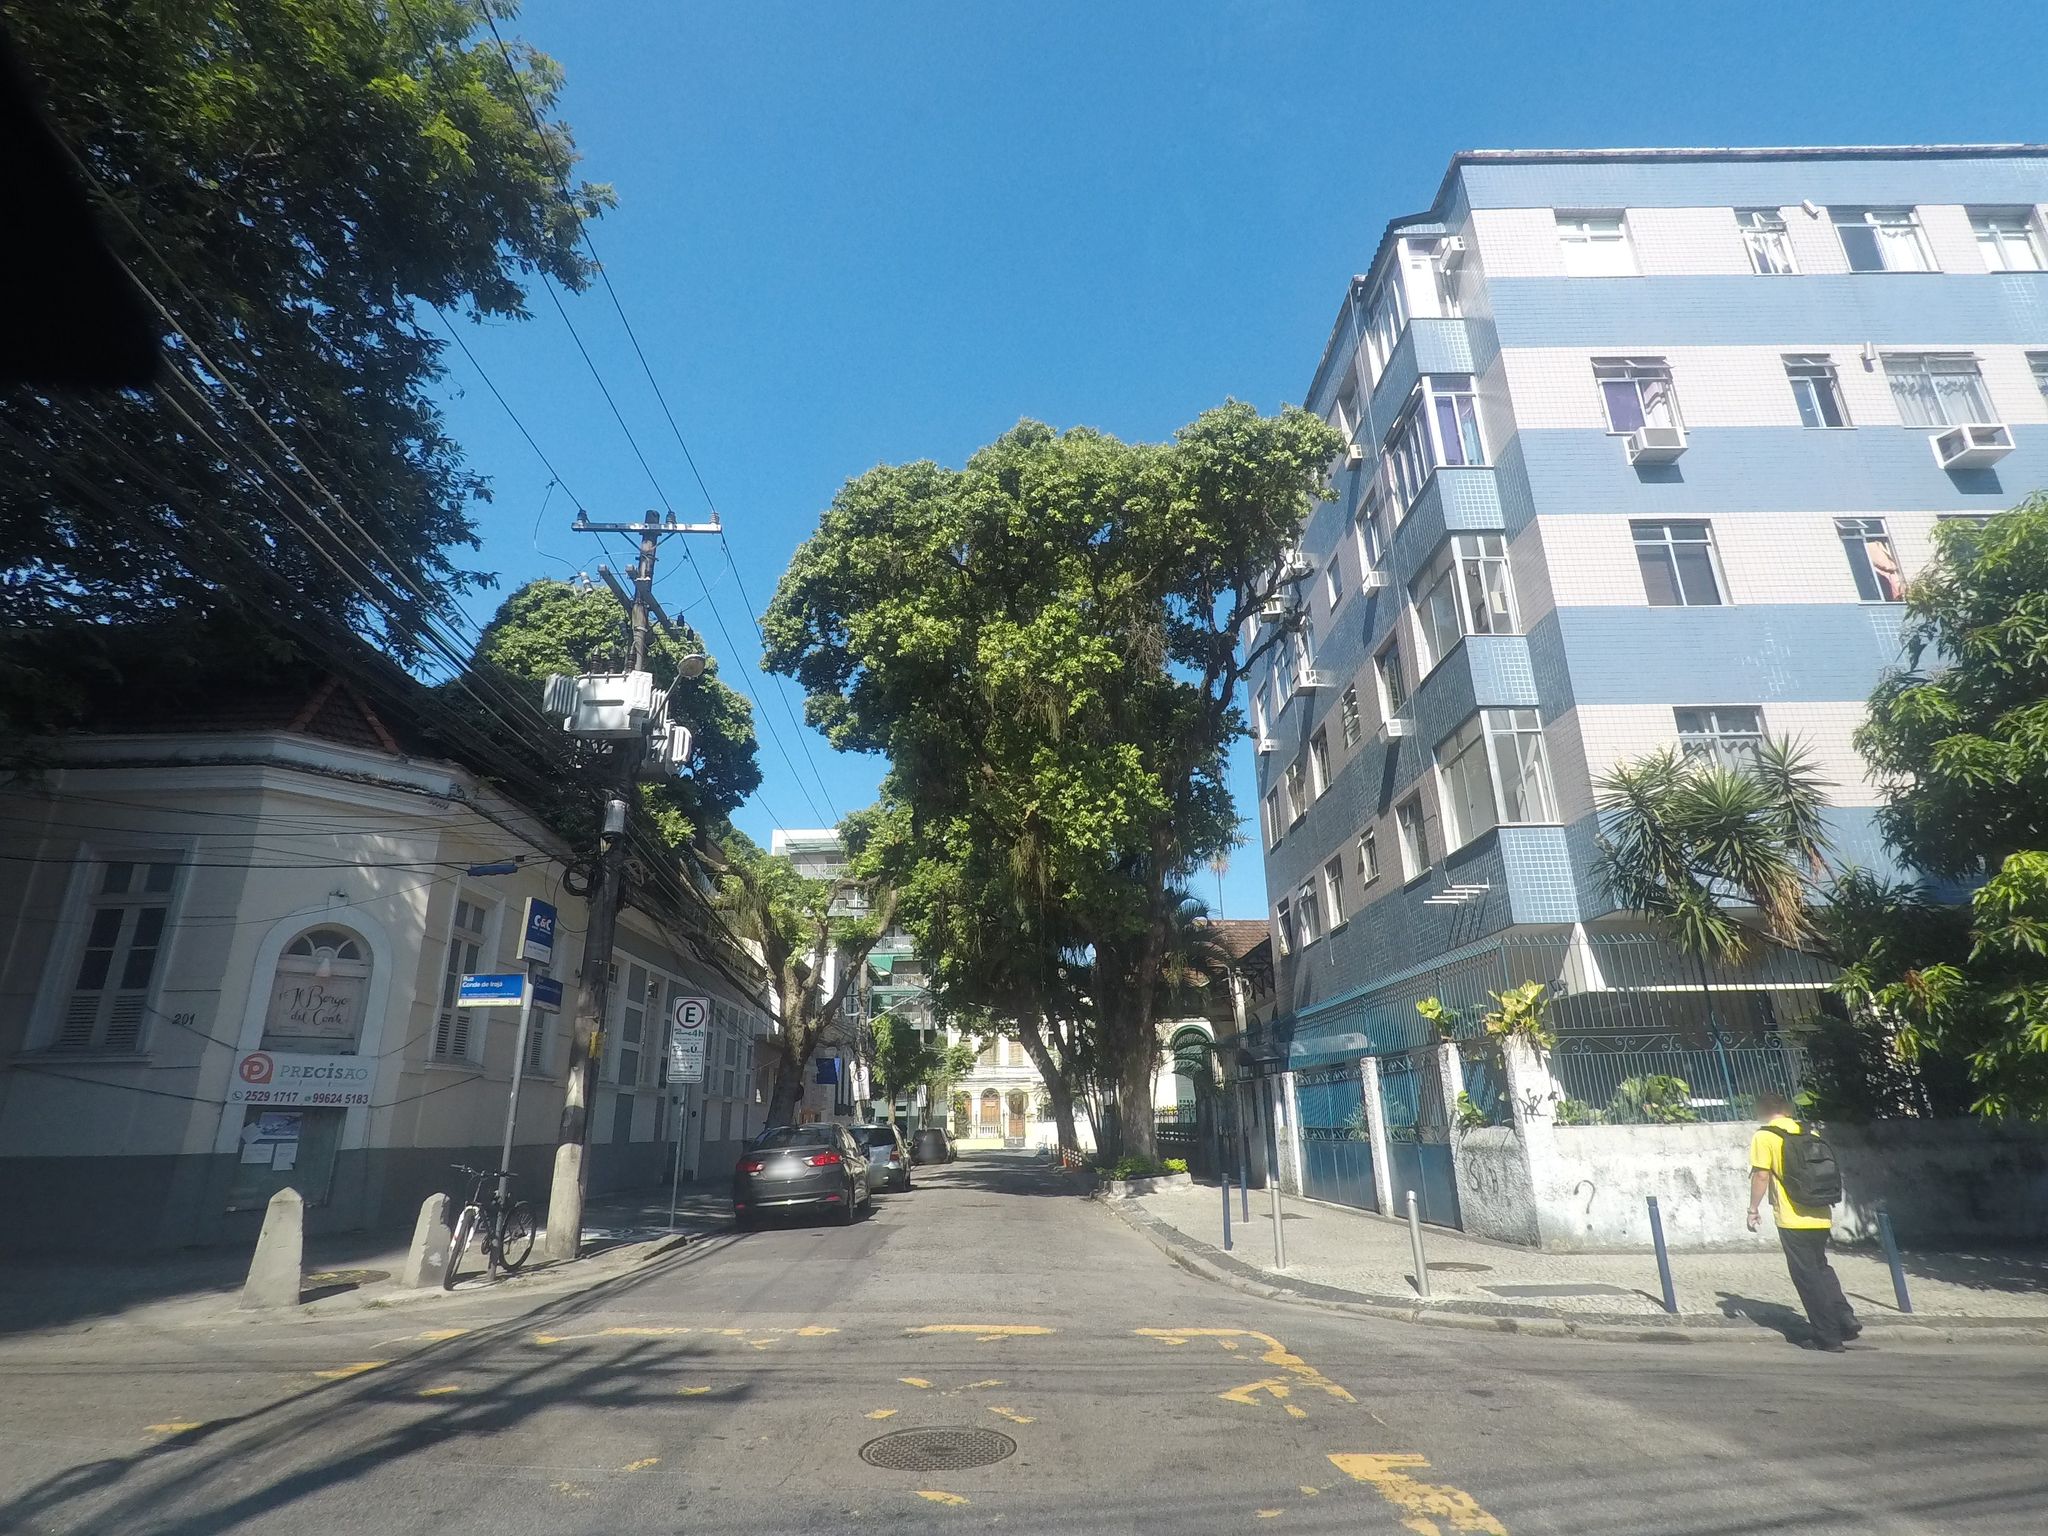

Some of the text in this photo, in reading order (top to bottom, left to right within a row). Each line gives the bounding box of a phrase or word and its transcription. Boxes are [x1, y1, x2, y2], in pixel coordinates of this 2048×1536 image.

[533, 914, 552, 931] C&C
[172, 1013, 195, 1025] 201
[685, 1007, 696, 1023] E
[245, 1091, 369, 1105] 2529 1717 99624 5183
